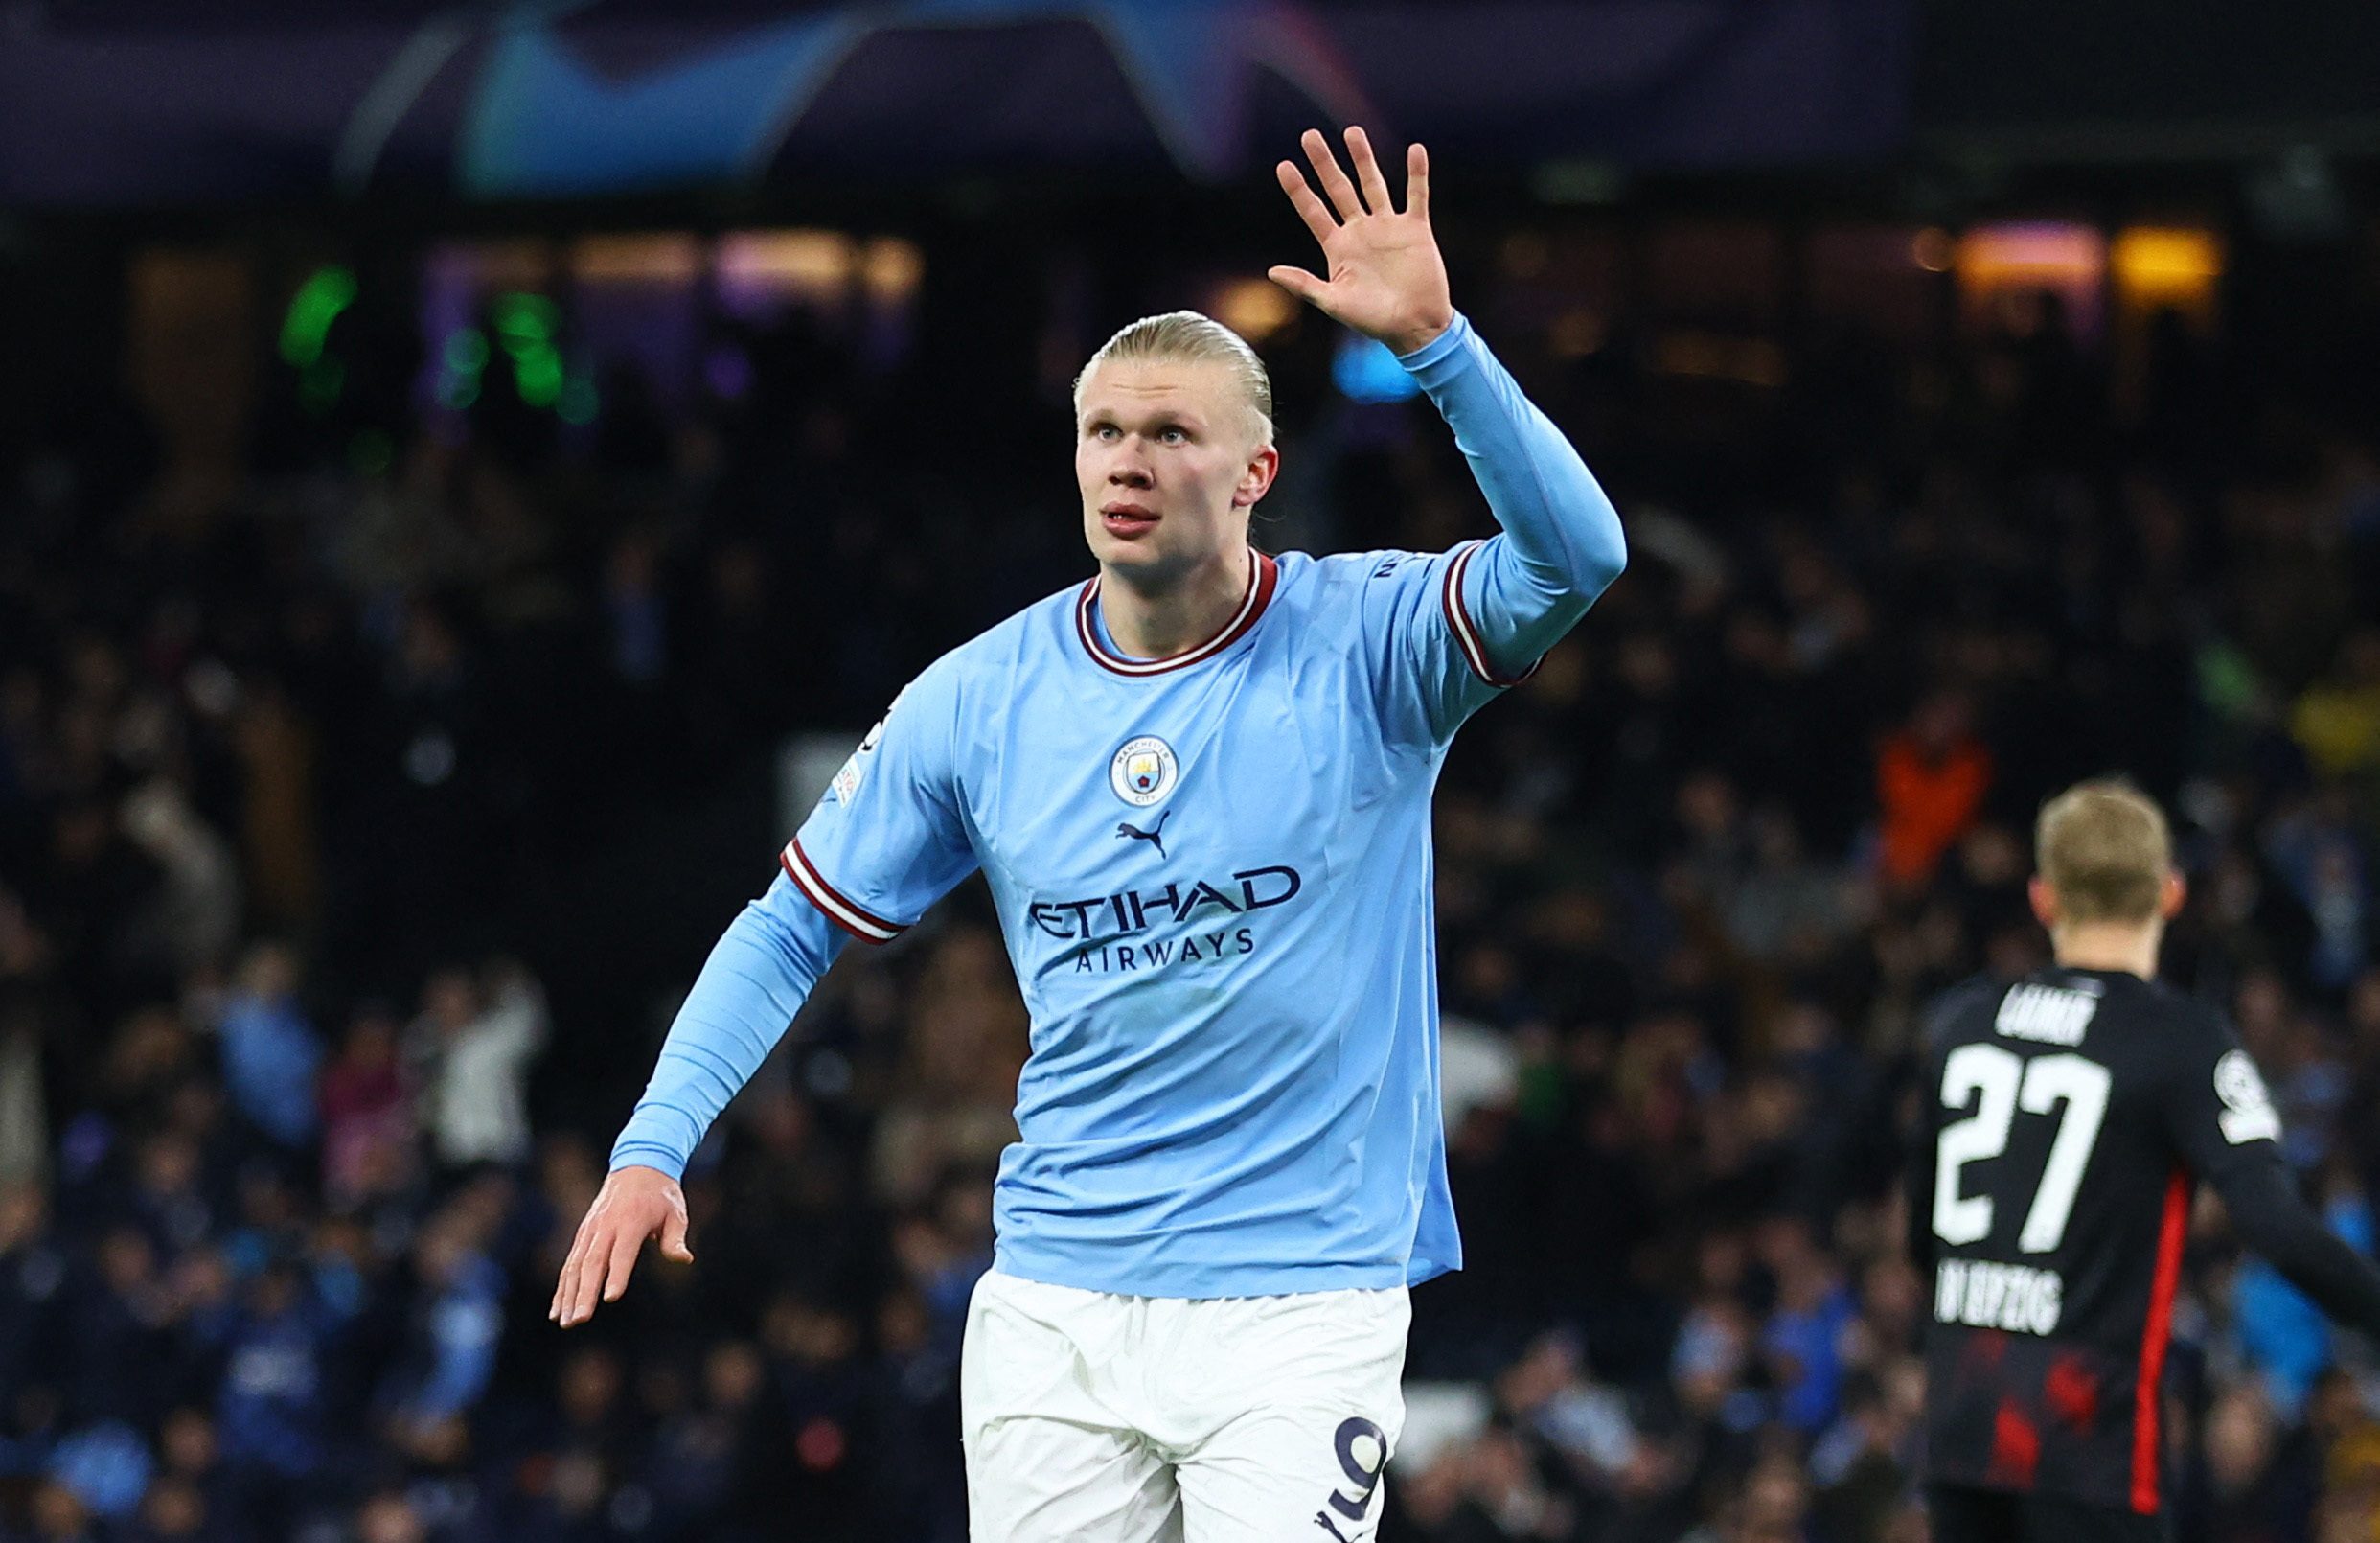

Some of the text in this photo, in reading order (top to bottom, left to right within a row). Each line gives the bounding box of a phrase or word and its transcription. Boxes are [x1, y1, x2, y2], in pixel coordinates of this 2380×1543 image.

[1031, 865, 1301, 939] ETIHAD
[1075, 927, 1255, 974] AIRWAYS
[1932, 1042, 2114, 1255] 27
[1328, 1416, 1387, 1522] 9
